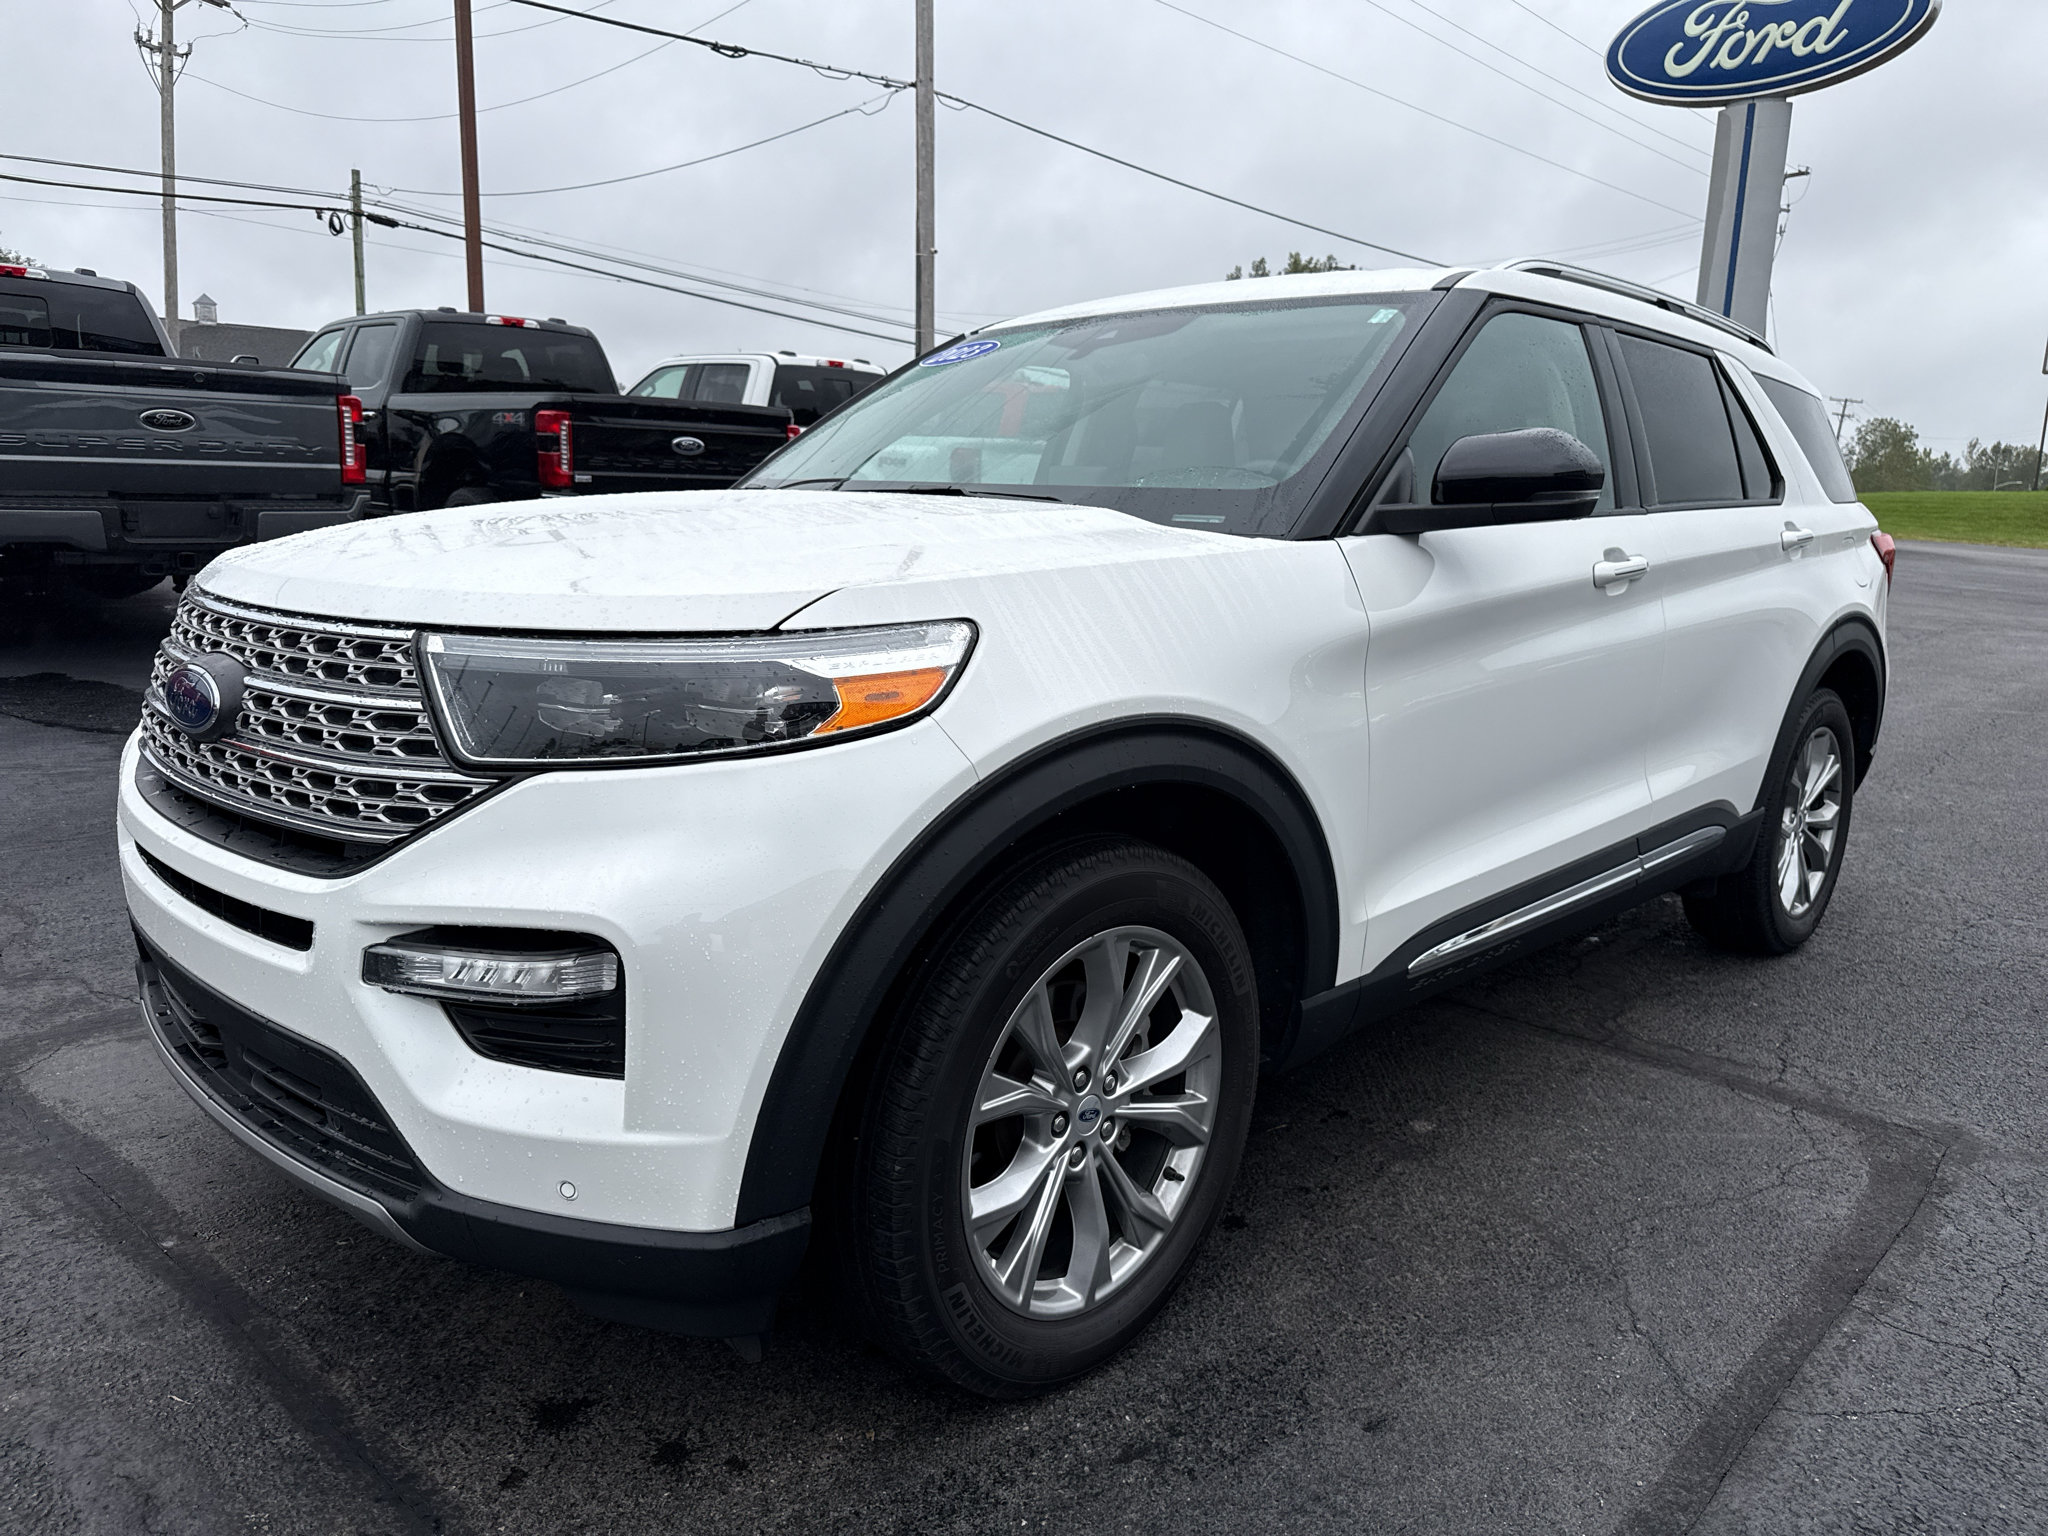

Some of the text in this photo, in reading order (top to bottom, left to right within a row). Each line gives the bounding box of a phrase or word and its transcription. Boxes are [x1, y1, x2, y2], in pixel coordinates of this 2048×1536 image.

[1663, 0, 1850, 79] Ford
[153, 413, 183, 427] Ford
[199, 440, 322, 456] DUTY
[1192, 904, 1246, 988] MICHELIN
[932, 1192, 949, 1273] PRIMACY
[949, 1289, 1024, 1369] MICHELIN
